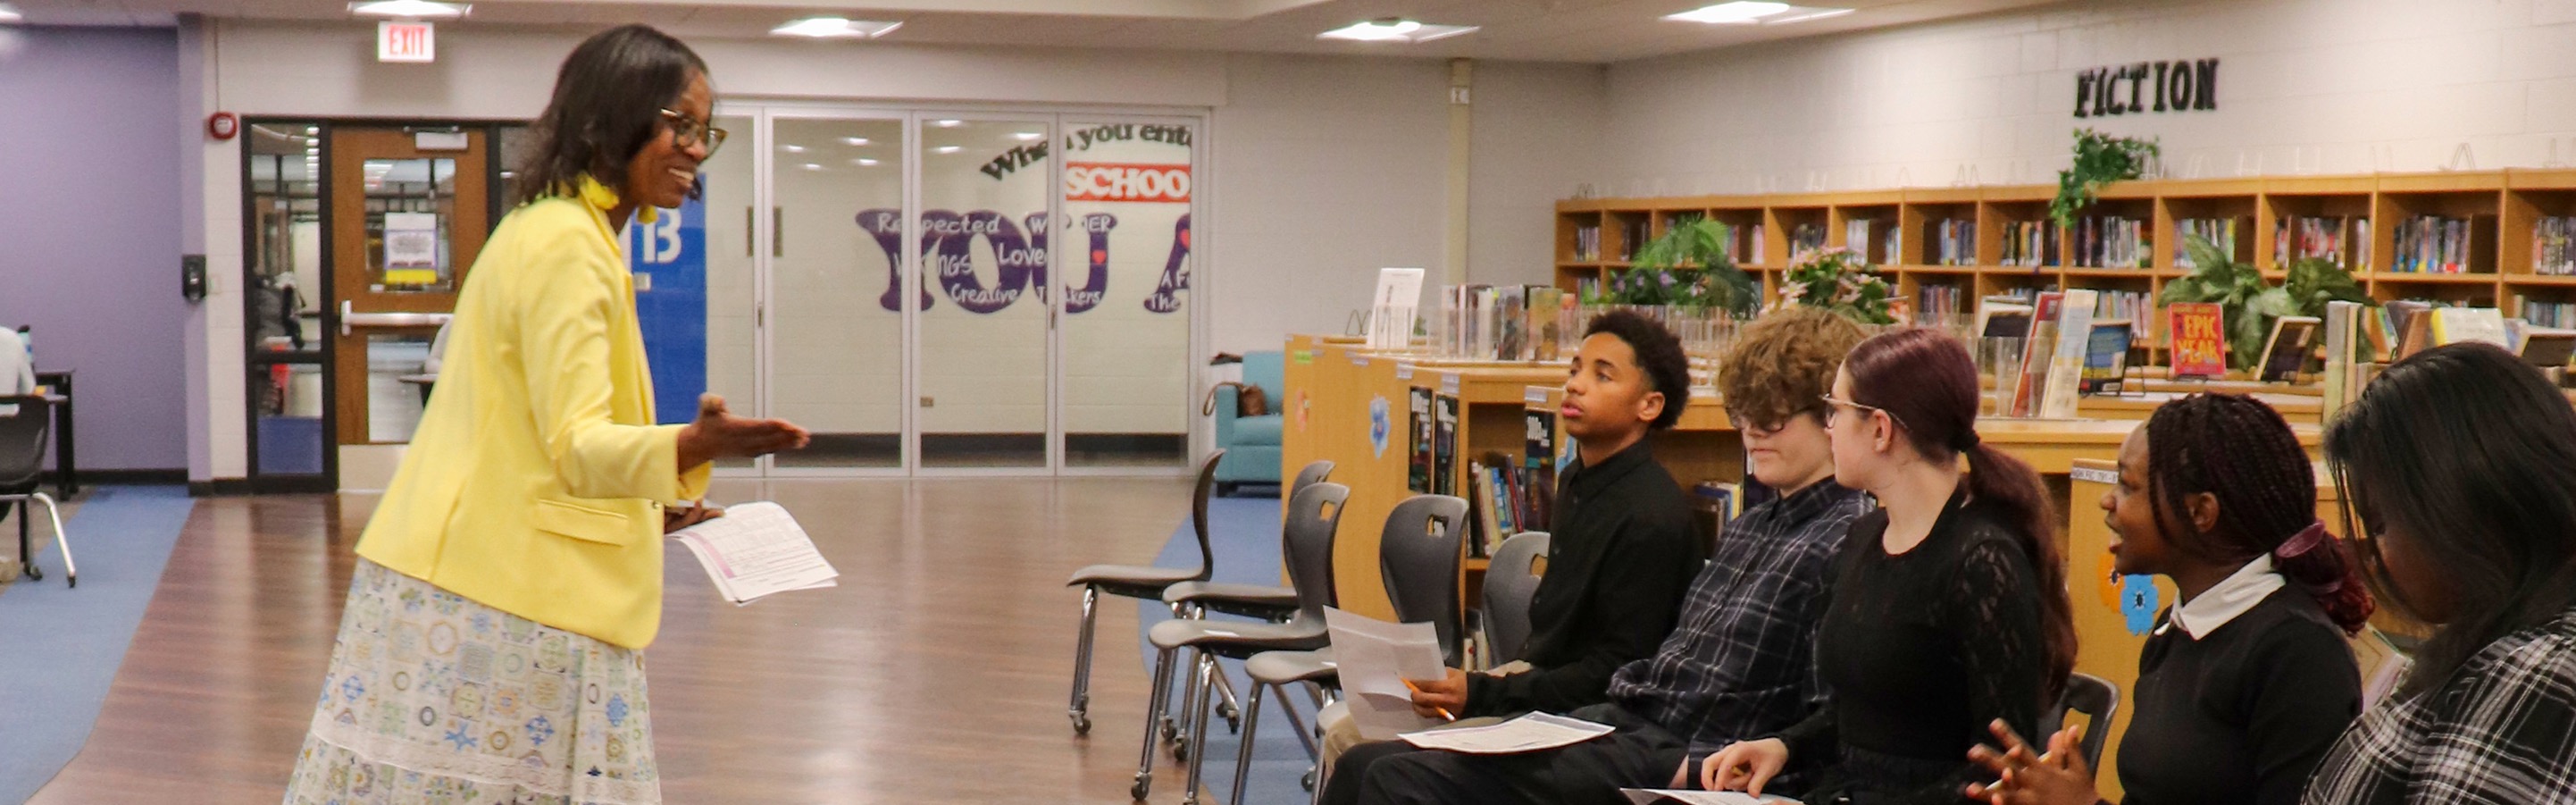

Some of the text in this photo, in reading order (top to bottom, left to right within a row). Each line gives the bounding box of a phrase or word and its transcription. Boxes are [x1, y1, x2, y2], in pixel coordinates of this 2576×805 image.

[388, 25, 427, 55] EXIT
[2074, 57, 2220, 118] FICTION
[981, 134, 1074, 181] Whe
[1076, 123, 1133, 151] you
[1066, 166, 1191, 198] SCHOO
[878, 213, 1001, 237] Repected
[855, 209, 1118, 314] YOU
[998, 242, 1048, 266] Love
[1150, 292, 1181, 312] The
[2184, 314, 2218, 339] EPIC
[2177, 340, 2221, 365] YEAR
